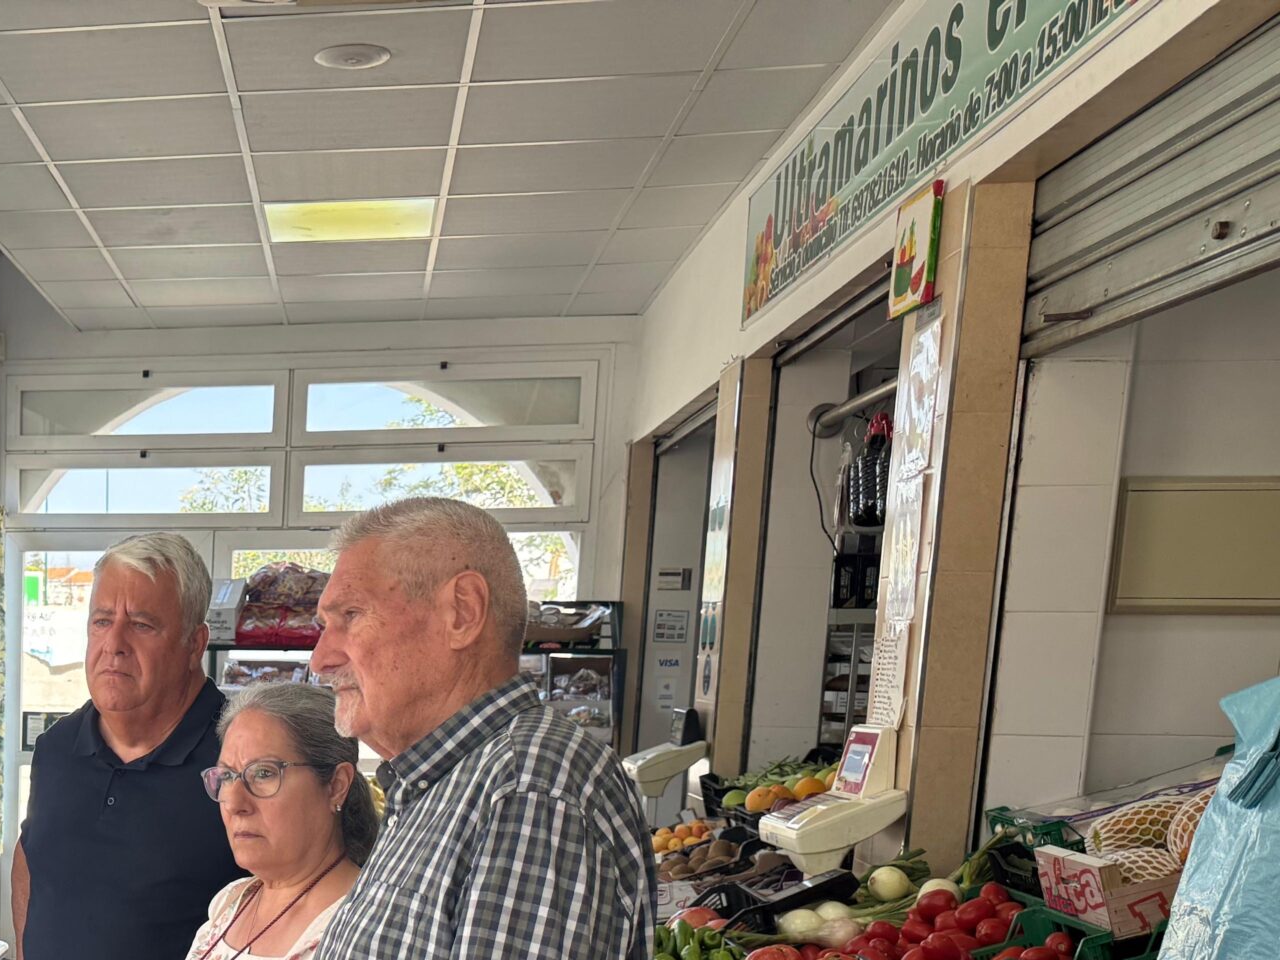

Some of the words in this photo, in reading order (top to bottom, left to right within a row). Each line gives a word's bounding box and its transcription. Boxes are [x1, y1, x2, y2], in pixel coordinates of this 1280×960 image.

[772, 2, 964, 252] Ultramarinos
[915, 106, 962, 178] Horario
[962, 89, 982, 139] de
[983, 51, 1019, 122] 7:00
[1020, 50, 1033, 92] a
[1033, 0, 1088, 80] 15:00
[658, 659, 680, 667] VISA
